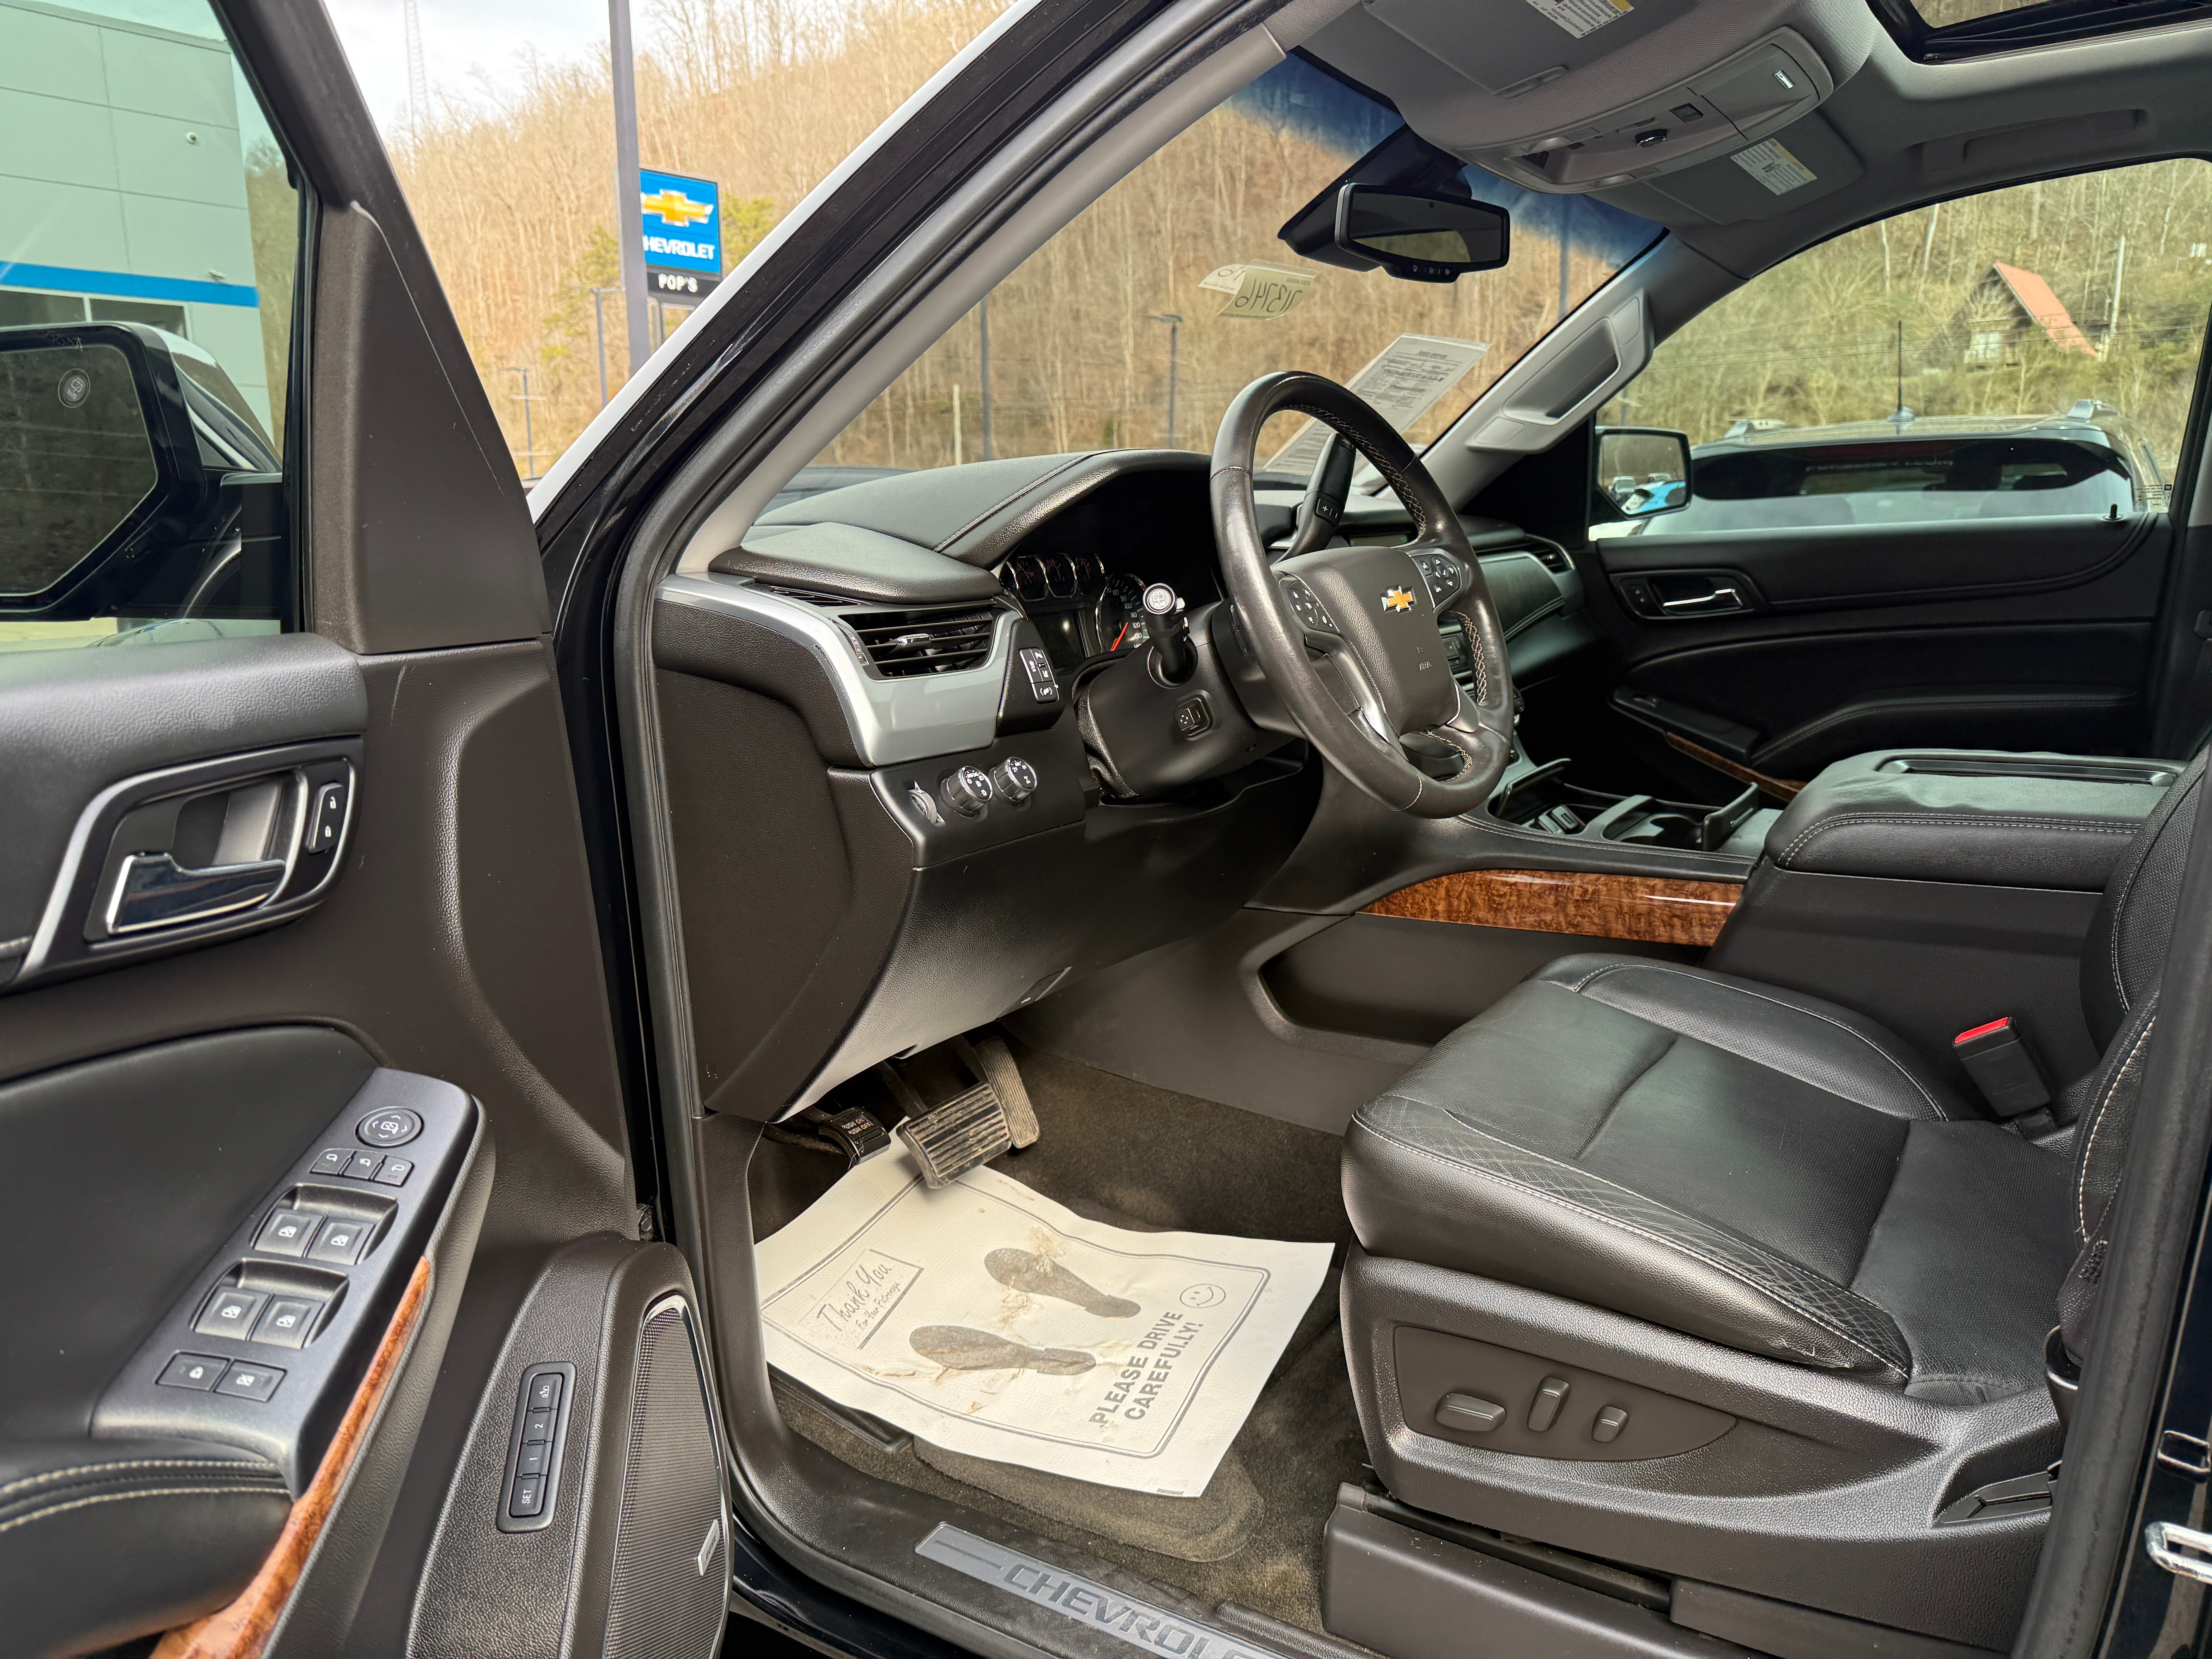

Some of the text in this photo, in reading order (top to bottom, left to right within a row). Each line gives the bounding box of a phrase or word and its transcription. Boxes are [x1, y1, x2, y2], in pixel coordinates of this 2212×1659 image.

[642, 235, 716, 260] HEVROLET
[658, 273, 698, 293] POP'S
[817, 1264, 892, 1331] Thank You
[856, 1319, 869, 1330] For
[864, 1310, 879, 1319] Your
[1088, 1311, 1183, 1424] PLEASE DRIVE
[1124, 1322, 1204, 1420] CAREFULLY!
[522, 1489, 532, 1504] SET
[1003, 1563, 1249, 1659] CHEVROL
